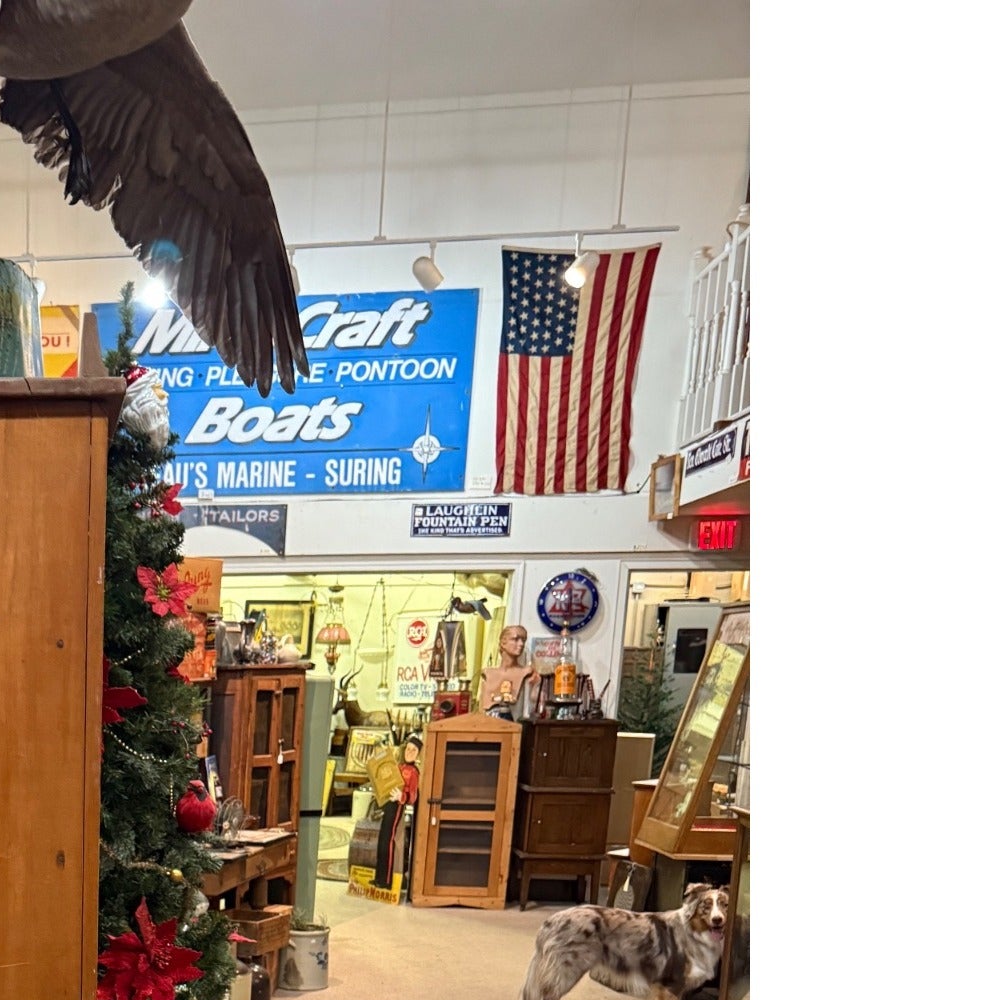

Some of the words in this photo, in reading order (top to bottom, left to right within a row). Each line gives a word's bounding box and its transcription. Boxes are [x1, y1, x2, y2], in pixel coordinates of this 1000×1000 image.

[335, 358, 457, 382] PONTOON
[184, 396, 364, 445] Boats
[160, 461, 208, 489] AU'S
[216, 460, 297, 489] MARINE
[324, 457, 402, 487] SURING
[211, 509, 280, 523] TAILORS
[426, 504, 498, 516] LAUGHLIN
[414, 516, 477, 528] FOUNTAIN
[480, 515, 508, 527] PEN
[698, 520, 737, 550] EXIT
[397, 665, 418, 682] RCA
